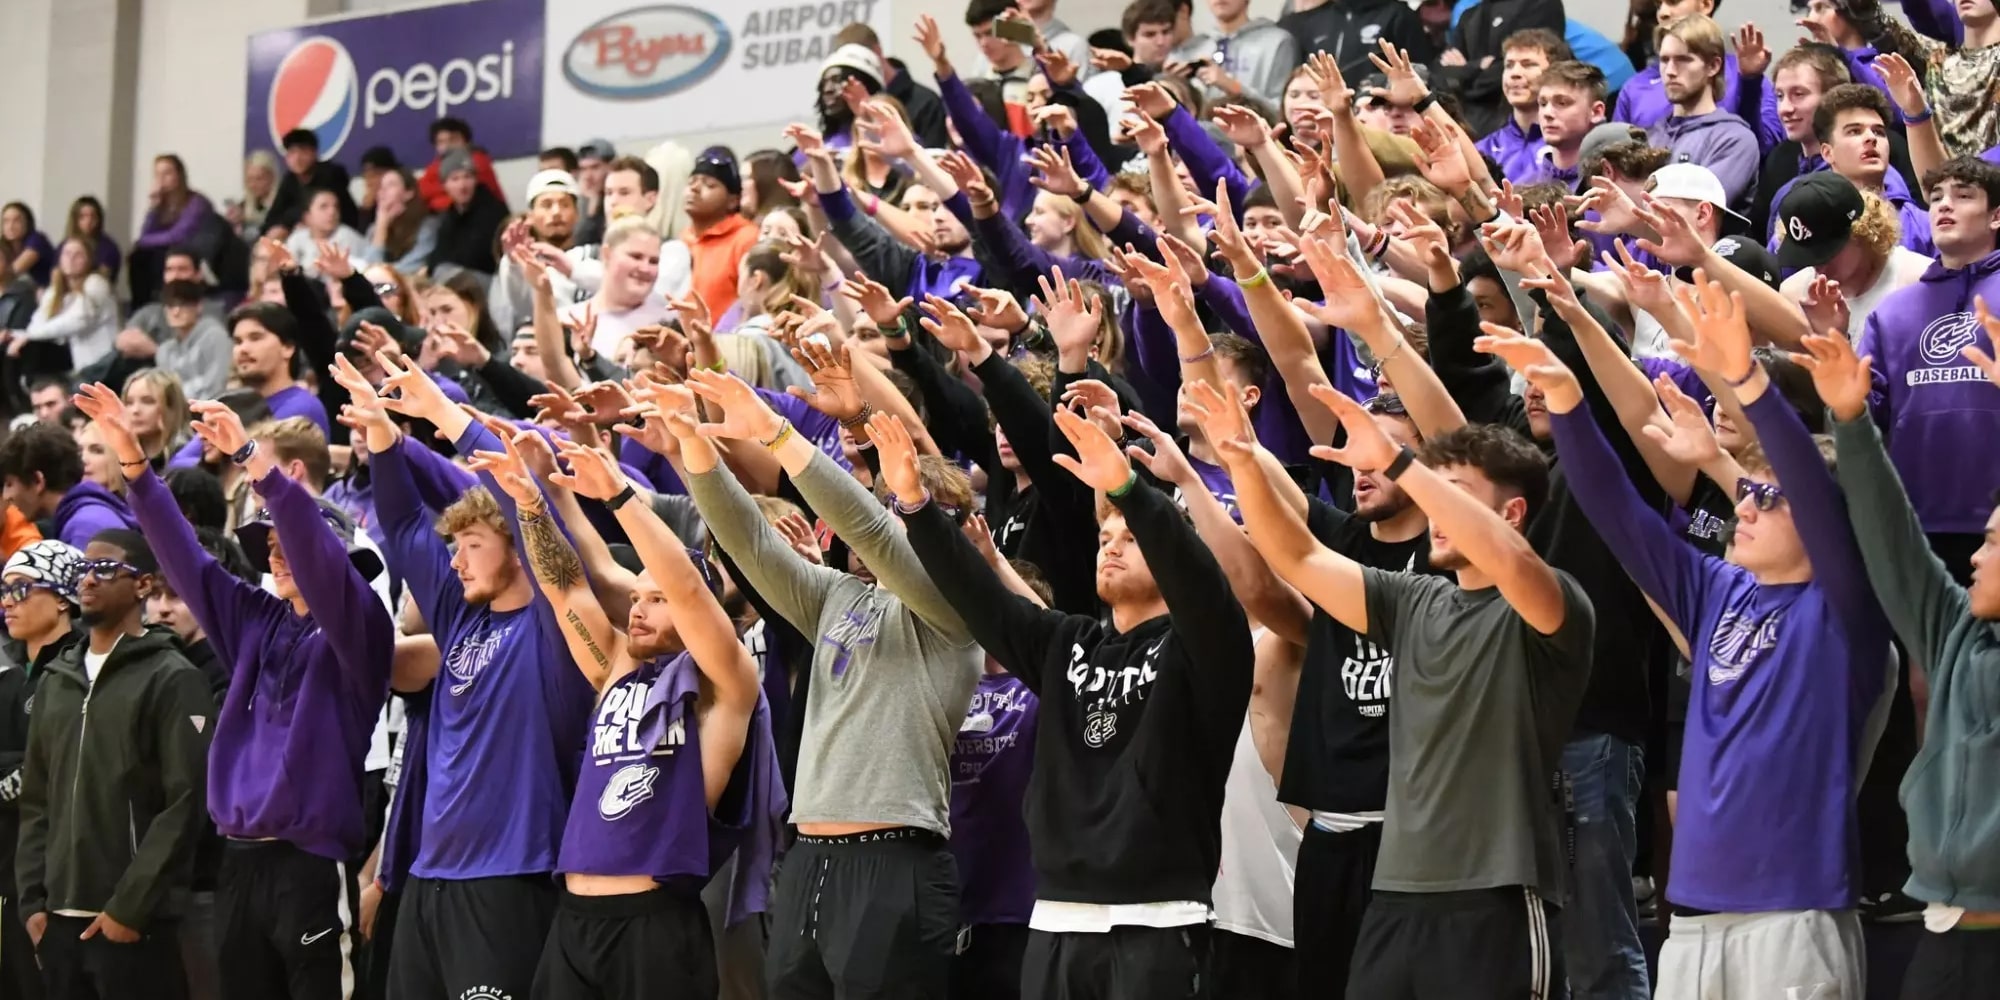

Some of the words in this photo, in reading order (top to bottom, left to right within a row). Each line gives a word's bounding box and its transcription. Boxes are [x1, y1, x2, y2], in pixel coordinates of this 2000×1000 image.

[741, 0, 878, 38] AIRPORT
[742, 34, 838, 70] SUBA
[364, 39, 515, 129] pepsi
[1913, 367, 1989, 383] BASEBALL
[968, 687, 1027, 714] PITAL
[953, 731, 1019, 755] VERSITY
